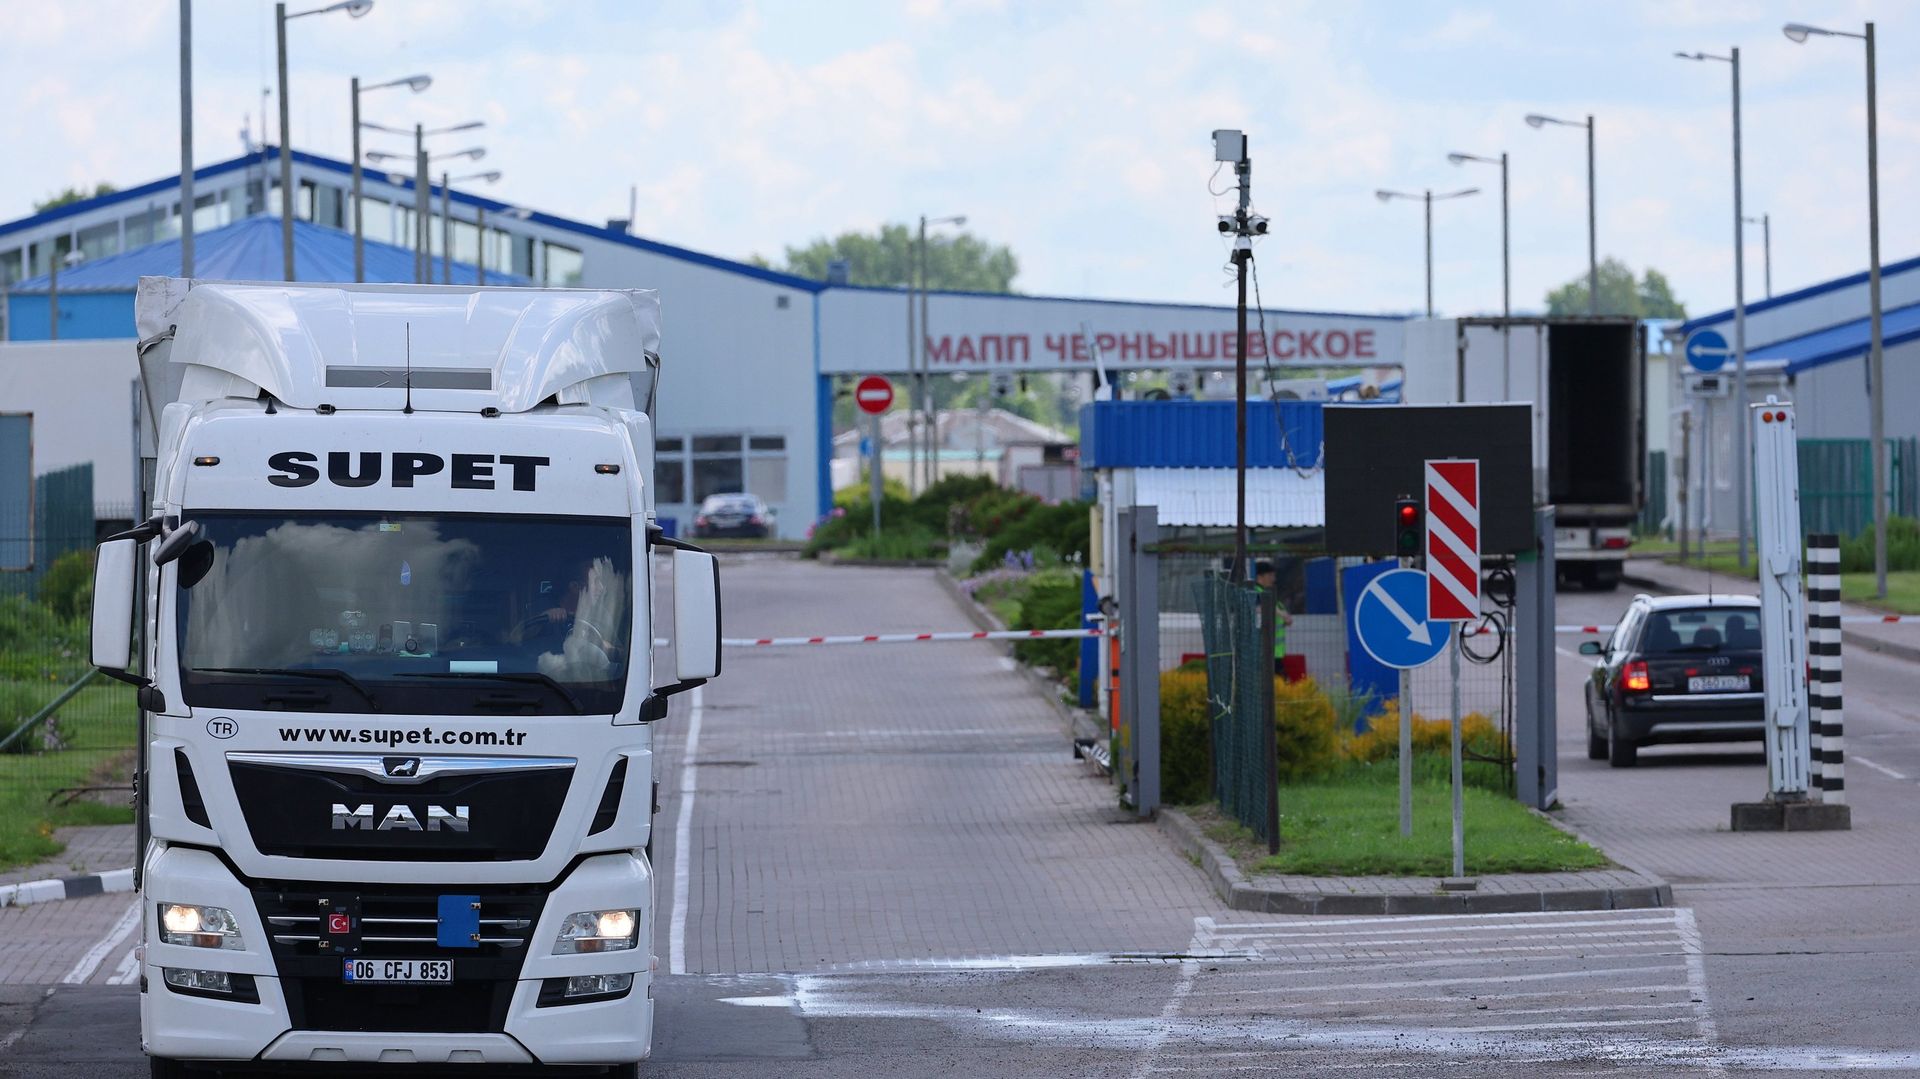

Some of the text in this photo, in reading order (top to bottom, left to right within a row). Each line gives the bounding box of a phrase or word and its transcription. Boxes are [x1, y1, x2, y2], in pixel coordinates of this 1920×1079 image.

[926, 329, 1376, 364] МАПП ЧЕРНЫШЕВСКОЕ
[268, 451, 550, 491] SUPET
[213, 722, 233, 735] TR
[279, 727, 527, 747] www.supet.com.tr
[332, 803, 469, 832] MAN
[356, 962, 449, 979] 06 CFJ 853
